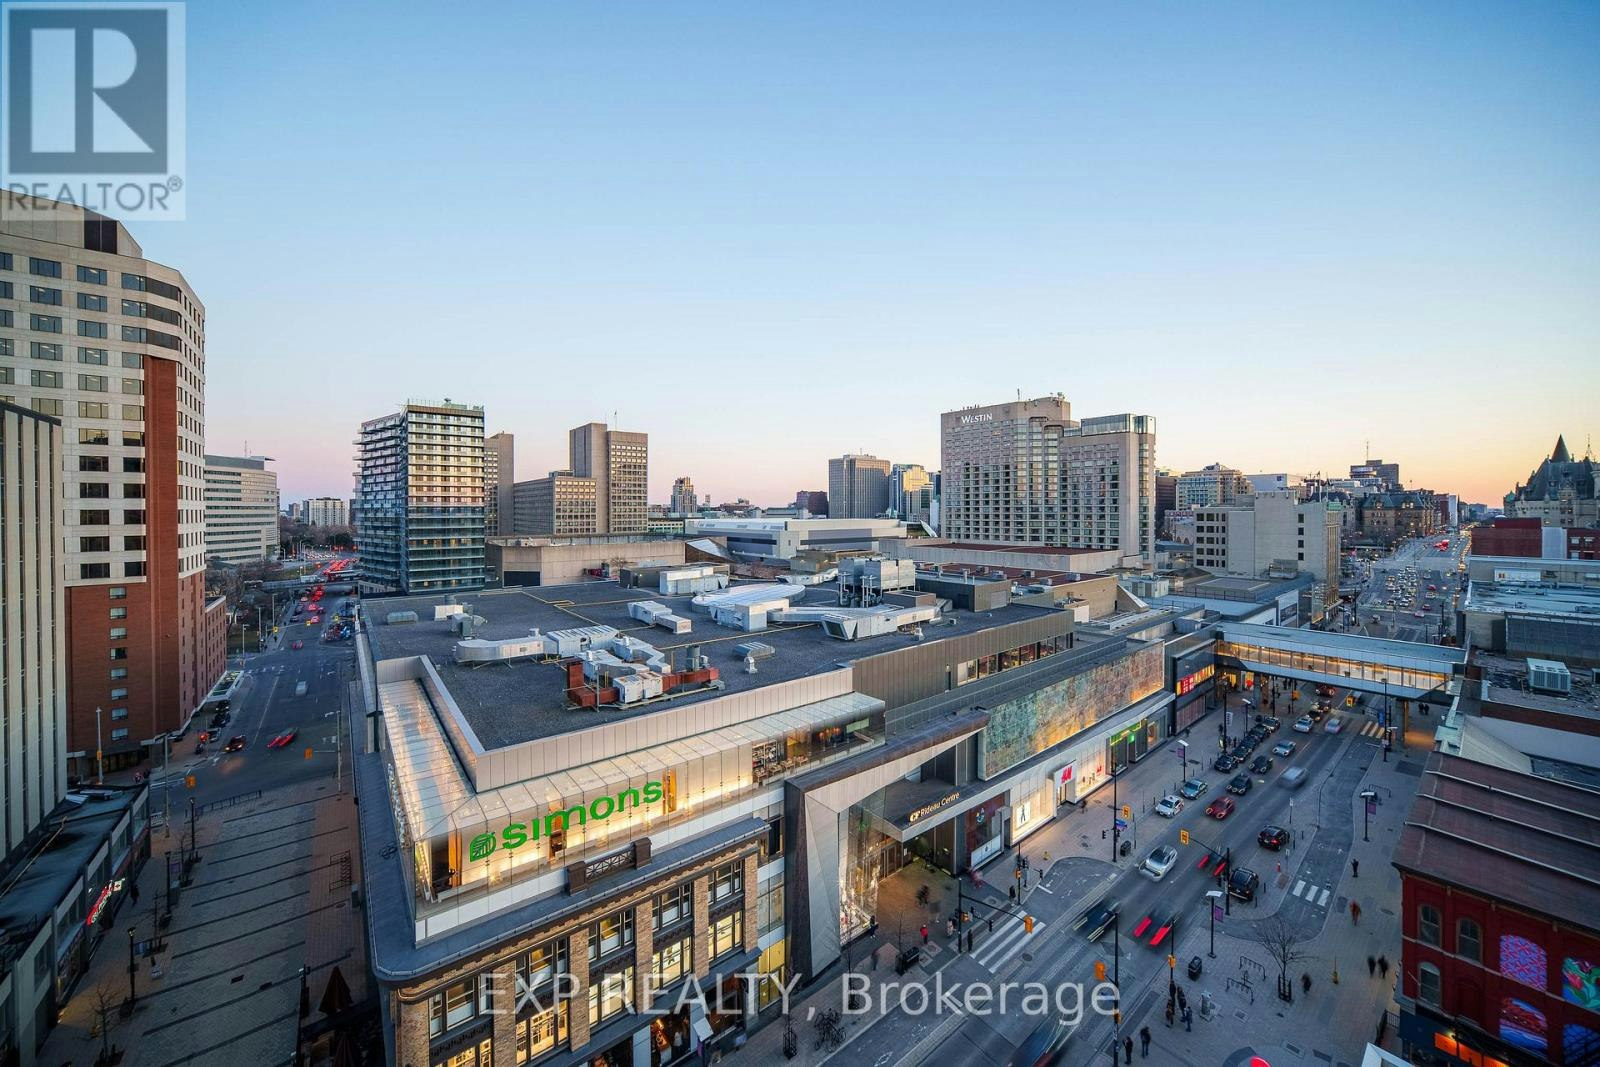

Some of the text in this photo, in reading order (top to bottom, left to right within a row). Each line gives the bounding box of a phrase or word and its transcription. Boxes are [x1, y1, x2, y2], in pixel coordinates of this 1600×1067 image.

[502, 780, 663, 850] simons
[920, 803, 941, 817] Rideau
[941, 792, 960, 806] Centre
